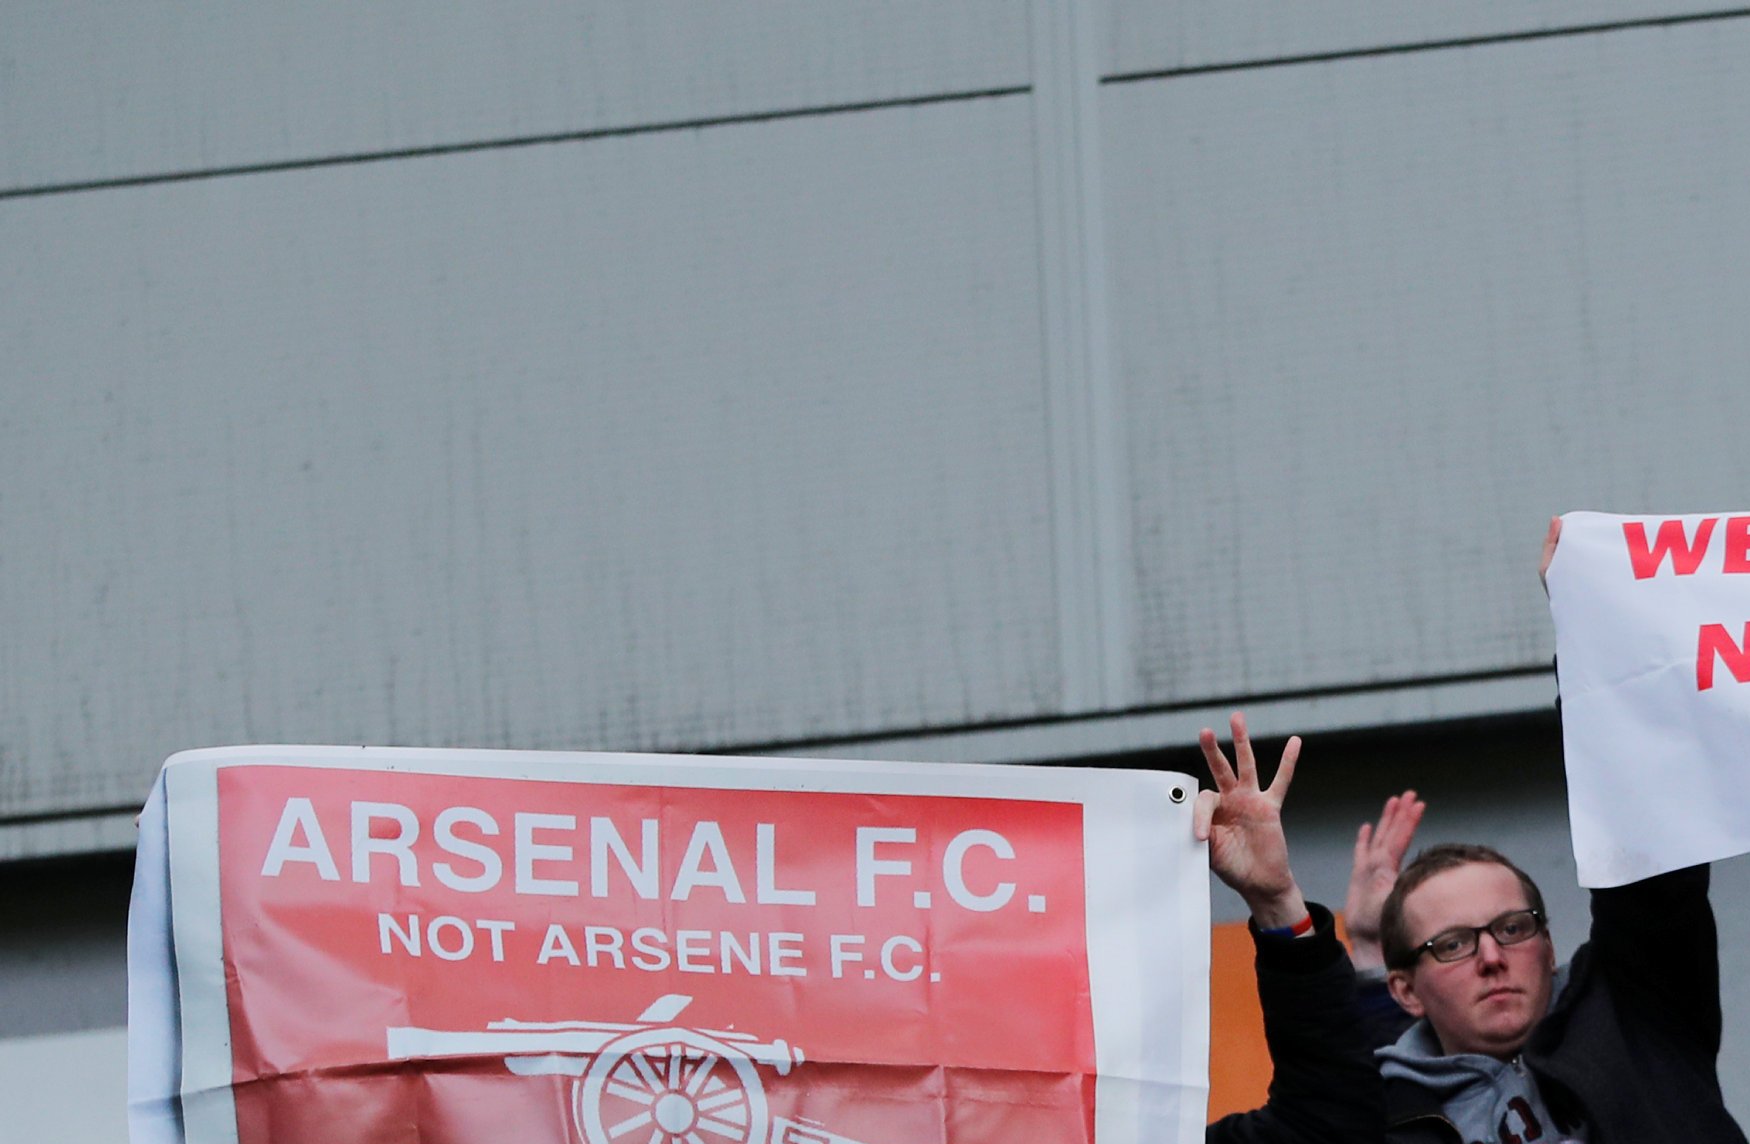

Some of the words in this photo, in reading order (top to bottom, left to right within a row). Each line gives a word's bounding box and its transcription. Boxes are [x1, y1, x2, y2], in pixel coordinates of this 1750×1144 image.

[260, 796, 818, 907] ARSENAL
[856, 827, 1047, 913] F.C.
[378, 912, 516, 962] NOT
[537, 922, 808, 978] ARSENE
[829, 934, 942, 983] F.C.
